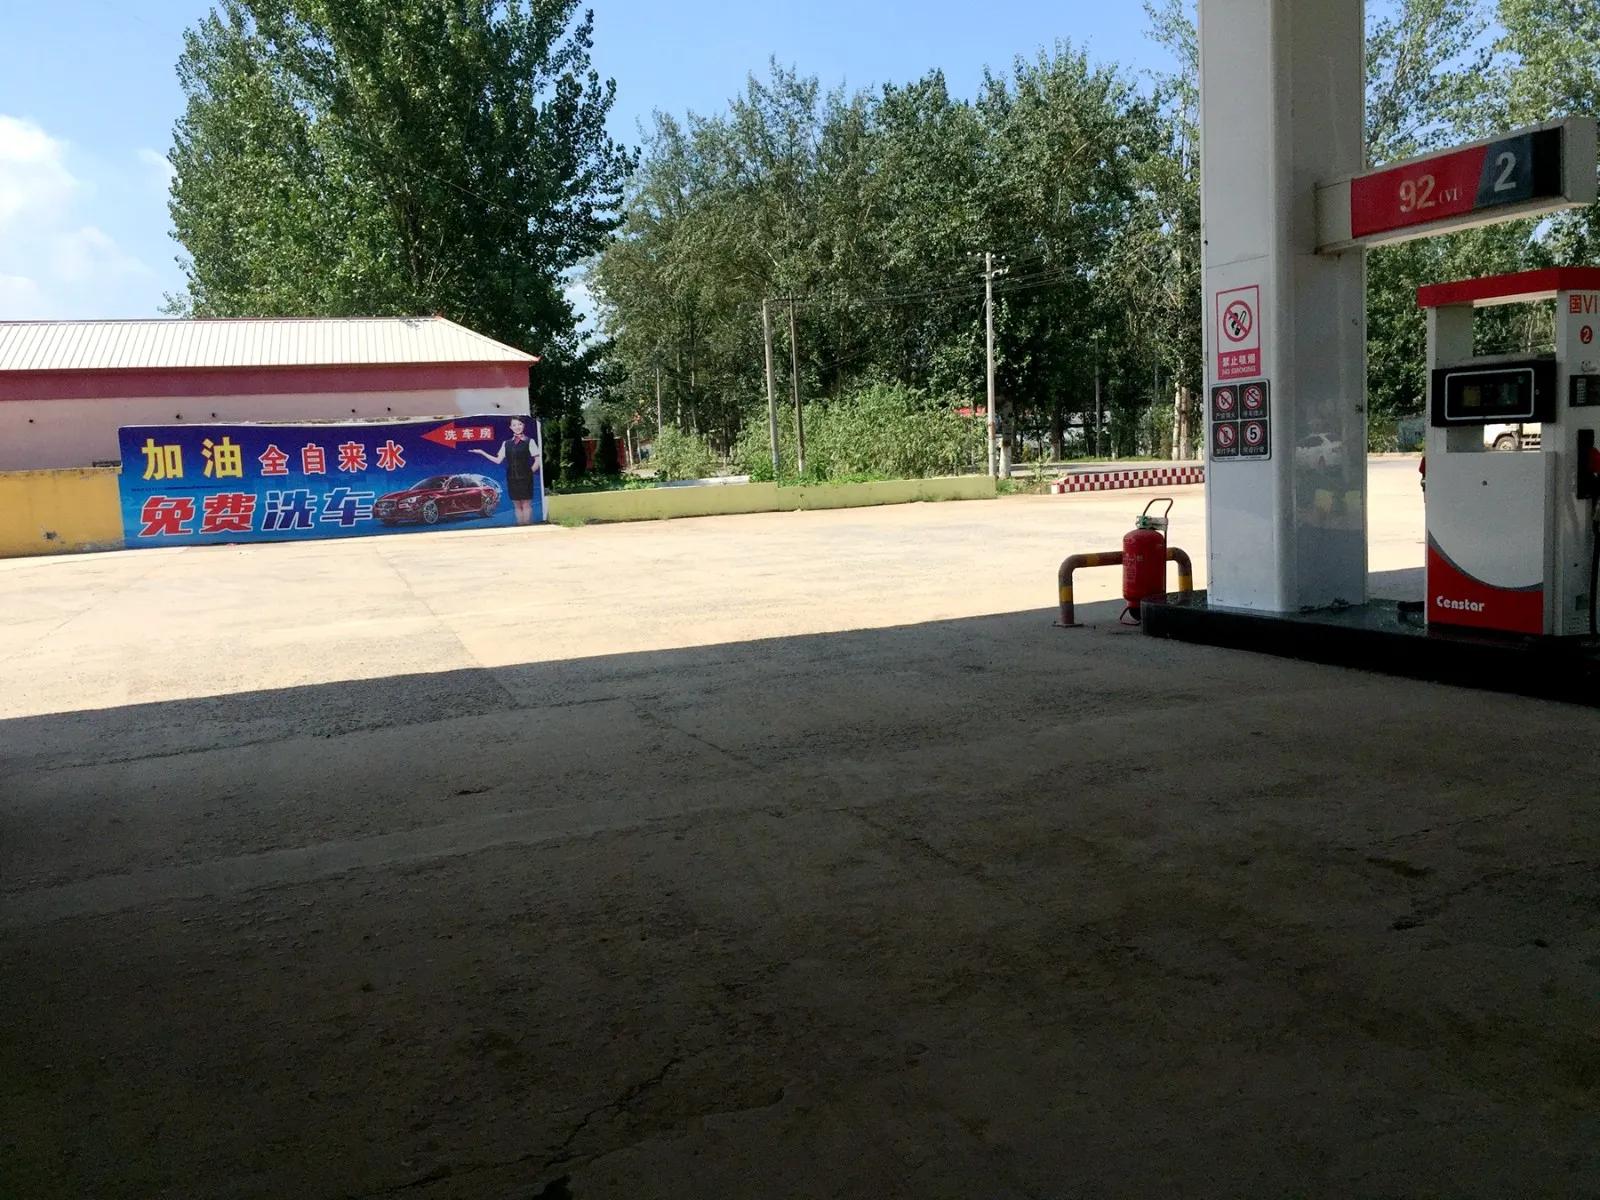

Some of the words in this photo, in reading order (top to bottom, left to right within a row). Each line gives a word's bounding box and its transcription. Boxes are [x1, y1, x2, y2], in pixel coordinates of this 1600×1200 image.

[1494, 152, 1517, 192] 2
[1400, 175, 1435, 212] 92
[444, 427, 492, 441] 洗车房
[1249, 427, 1258, 441] 5
[141, 436, 243, 480] 加油
[258, 440, 406, 476] 全自来水
[138, 486, 376, 538] 免费洗车
[1436, 595, 1485, 613] Censtar
